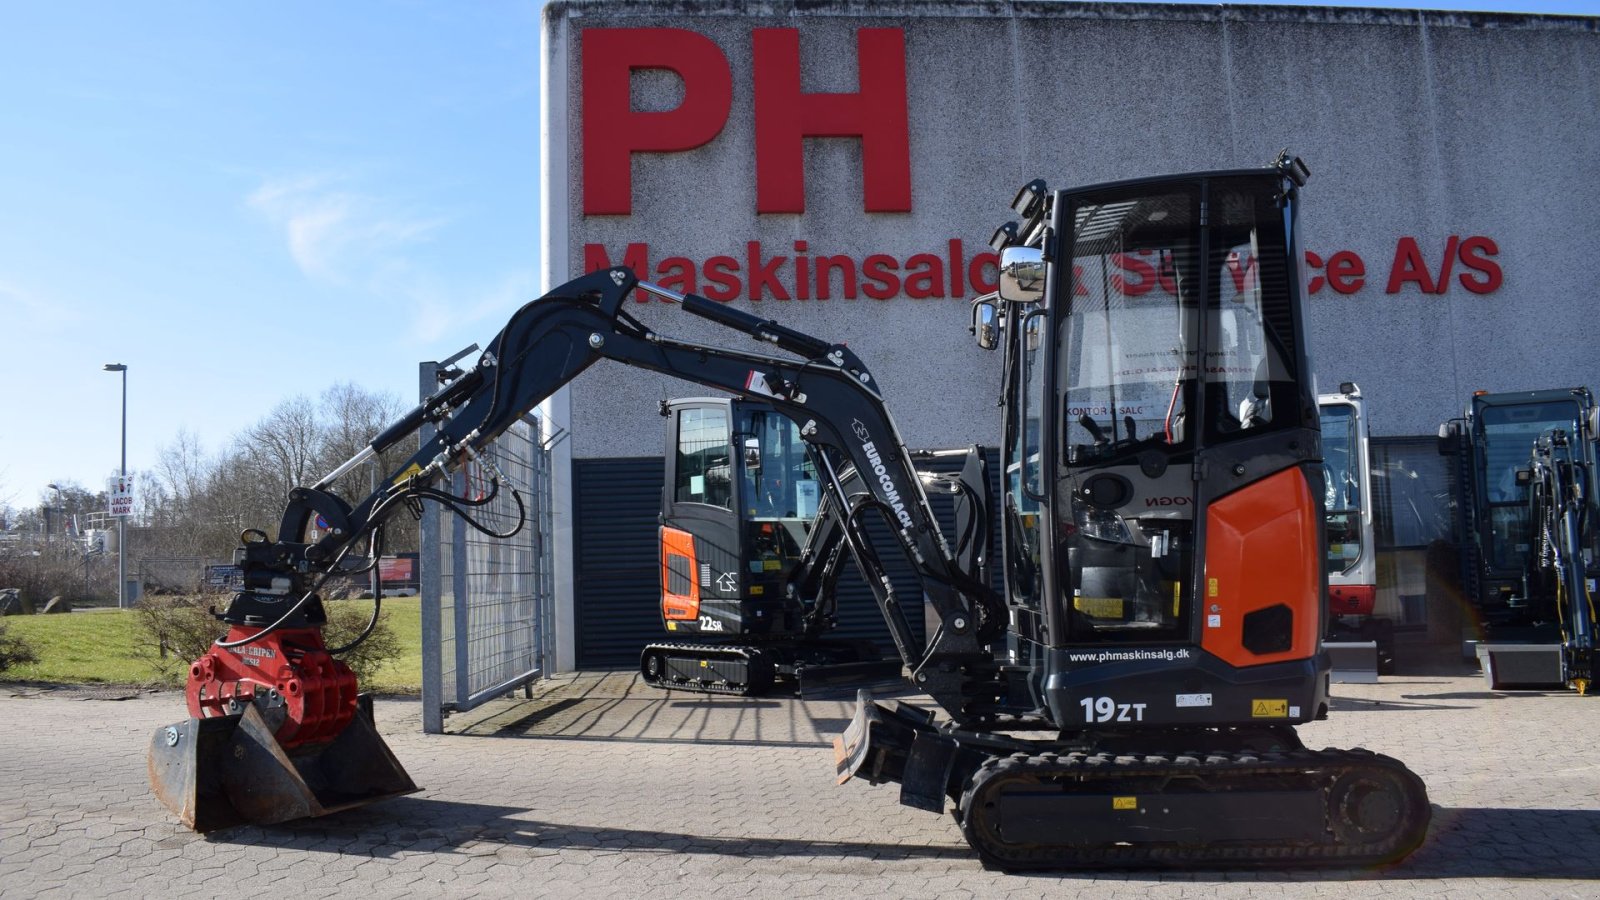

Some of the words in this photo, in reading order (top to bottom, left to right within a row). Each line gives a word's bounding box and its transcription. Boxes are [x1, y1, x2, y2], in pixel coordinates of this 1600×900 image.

[582, 28, 911, 215] PH
[1386, 235, 1503, 295] A/S
[862, 441, 914, 529] EUROCOMACH
[111, 497, 133, 505] JACOB
[112, 506, 131, 514] MARK
[1070, 648, 1190, 662] www.phmaskinsalg.dk
[1080, 696, 1147, 723] 19ZT
